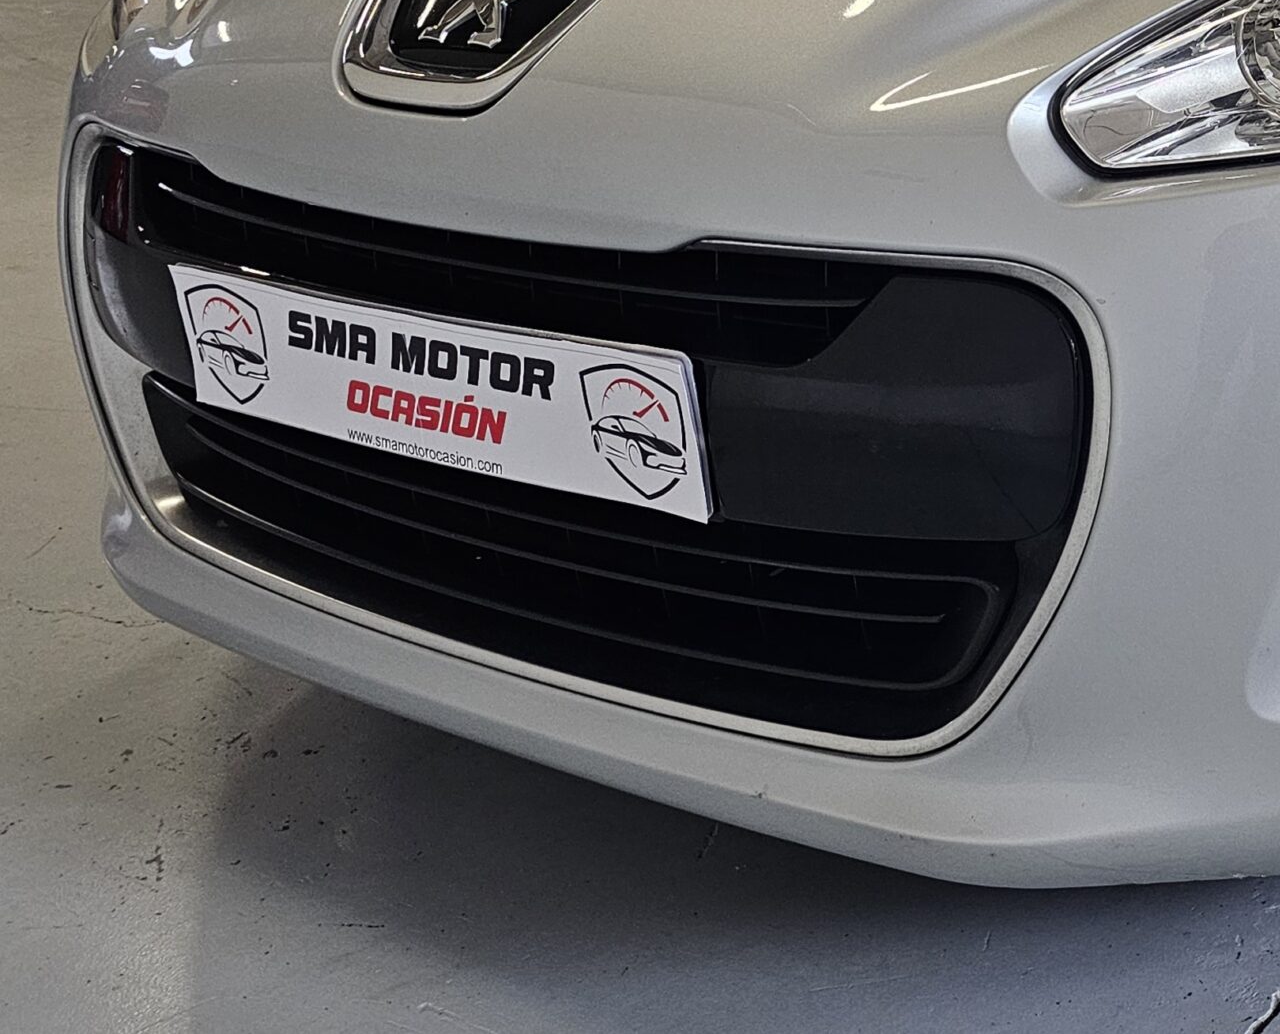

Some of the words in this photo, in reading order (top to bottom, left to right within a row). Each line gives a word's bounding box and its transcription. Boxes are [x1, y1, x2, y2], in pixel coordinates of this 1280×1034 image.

[288, 310, 377, 365] SMA
[391, 332, 555, 401] MOTOR
[346, 380, 507, 445] OCASIÓN
[347, 428, 504, 475] www.smamotorocasion.com
